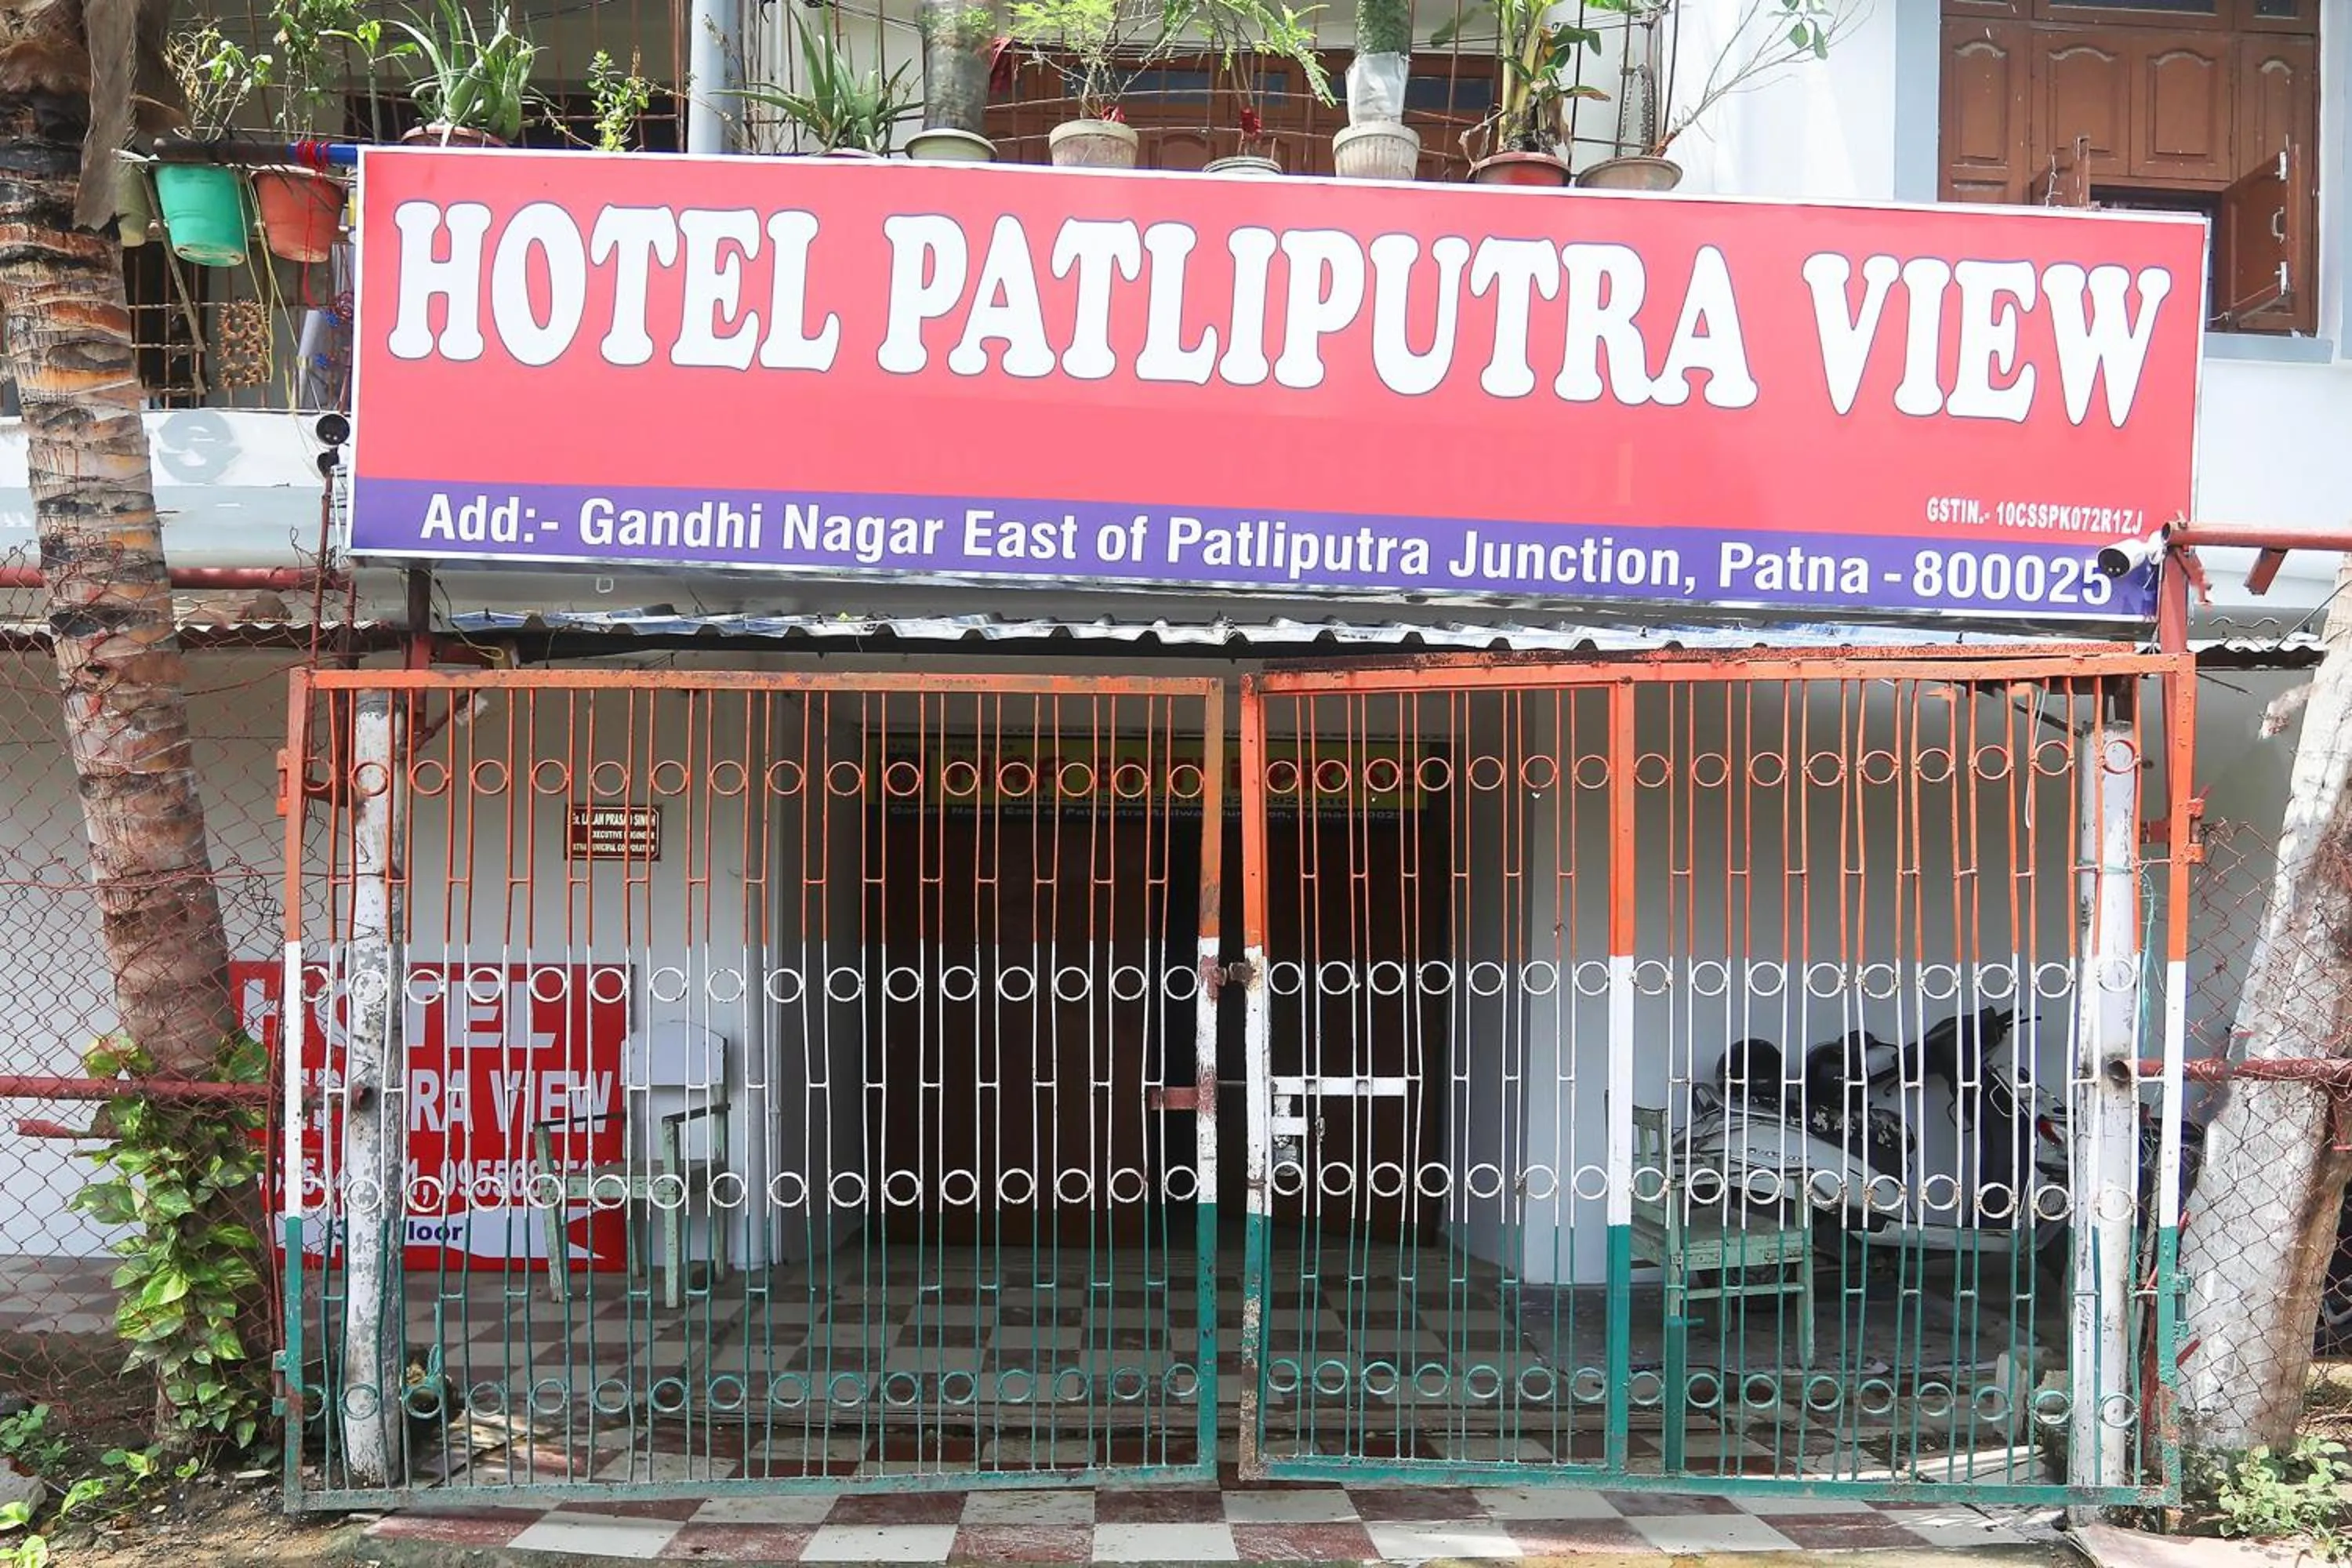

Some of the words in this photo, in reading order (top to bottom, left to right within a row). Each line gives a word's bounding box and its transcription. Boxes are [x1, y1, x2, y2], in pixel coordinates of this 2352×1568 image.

[388, 199, 840, 372] HOTEL
[876, 213, 1759, 408] PATLIPUTRA
[1801, 251, 2172, 429] VIEW
[420, 493, 560, 543] Add:-
[579, 498, 764, 550] Gandhi
[783, 503, 944, 563] Nagar
[963, 510, 1078, 560] East
[1097, 515, 1149, 562] of
[1167, 516, 1430, 579] Patliputra
[1448, 530, 1697, 595] Junction,
[1719, 542, 1869, 594] Patna
[1912, 550, 2112, 605] 800025
[489, 1070, 612, 1134] VIEW
[407, 1220, 463, 1241] loor
